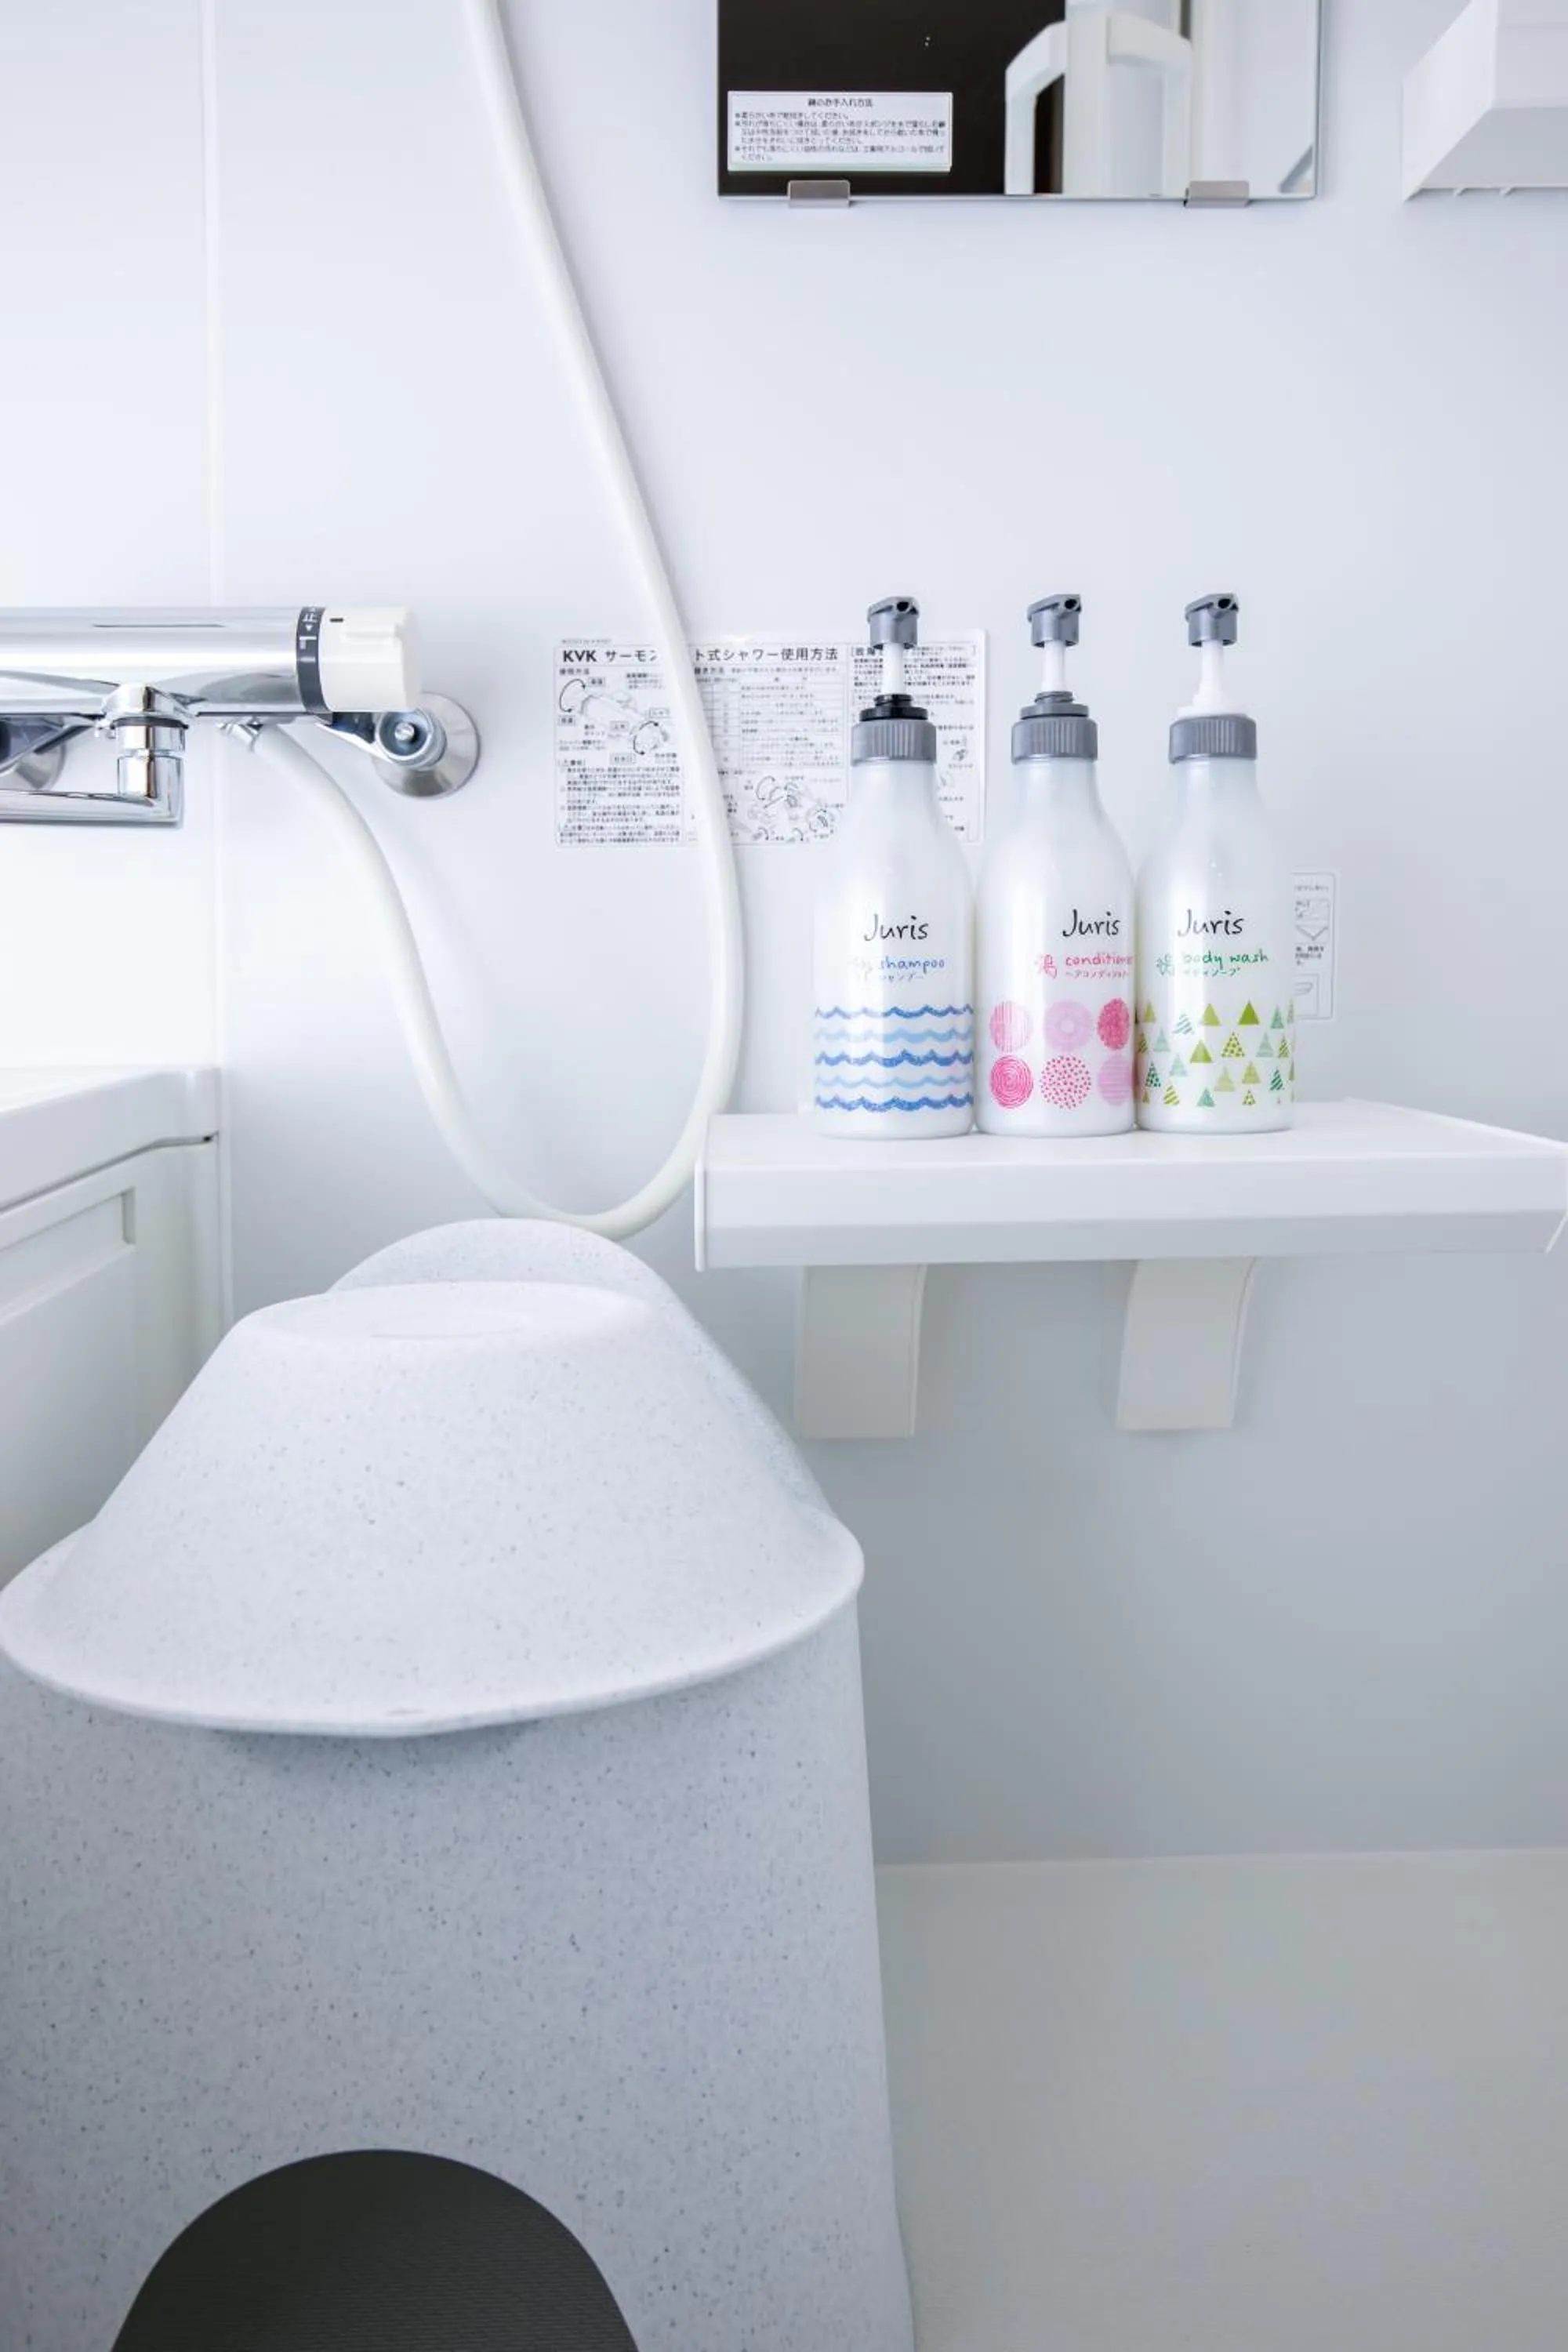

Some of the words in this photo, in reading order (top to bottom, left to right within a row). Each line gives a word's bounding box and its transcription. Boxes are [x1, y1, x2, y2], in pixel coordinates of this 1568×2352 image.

[563, 650, 597, 662] KVK
[863, 913, 929, 942] Juris
[1062, 909, 1121, 937] Juris
[1177, 909, 1244, 937] Juris
[879, 956, 946, 975] shampoo
[1229, 948, 1269, 964] wash
